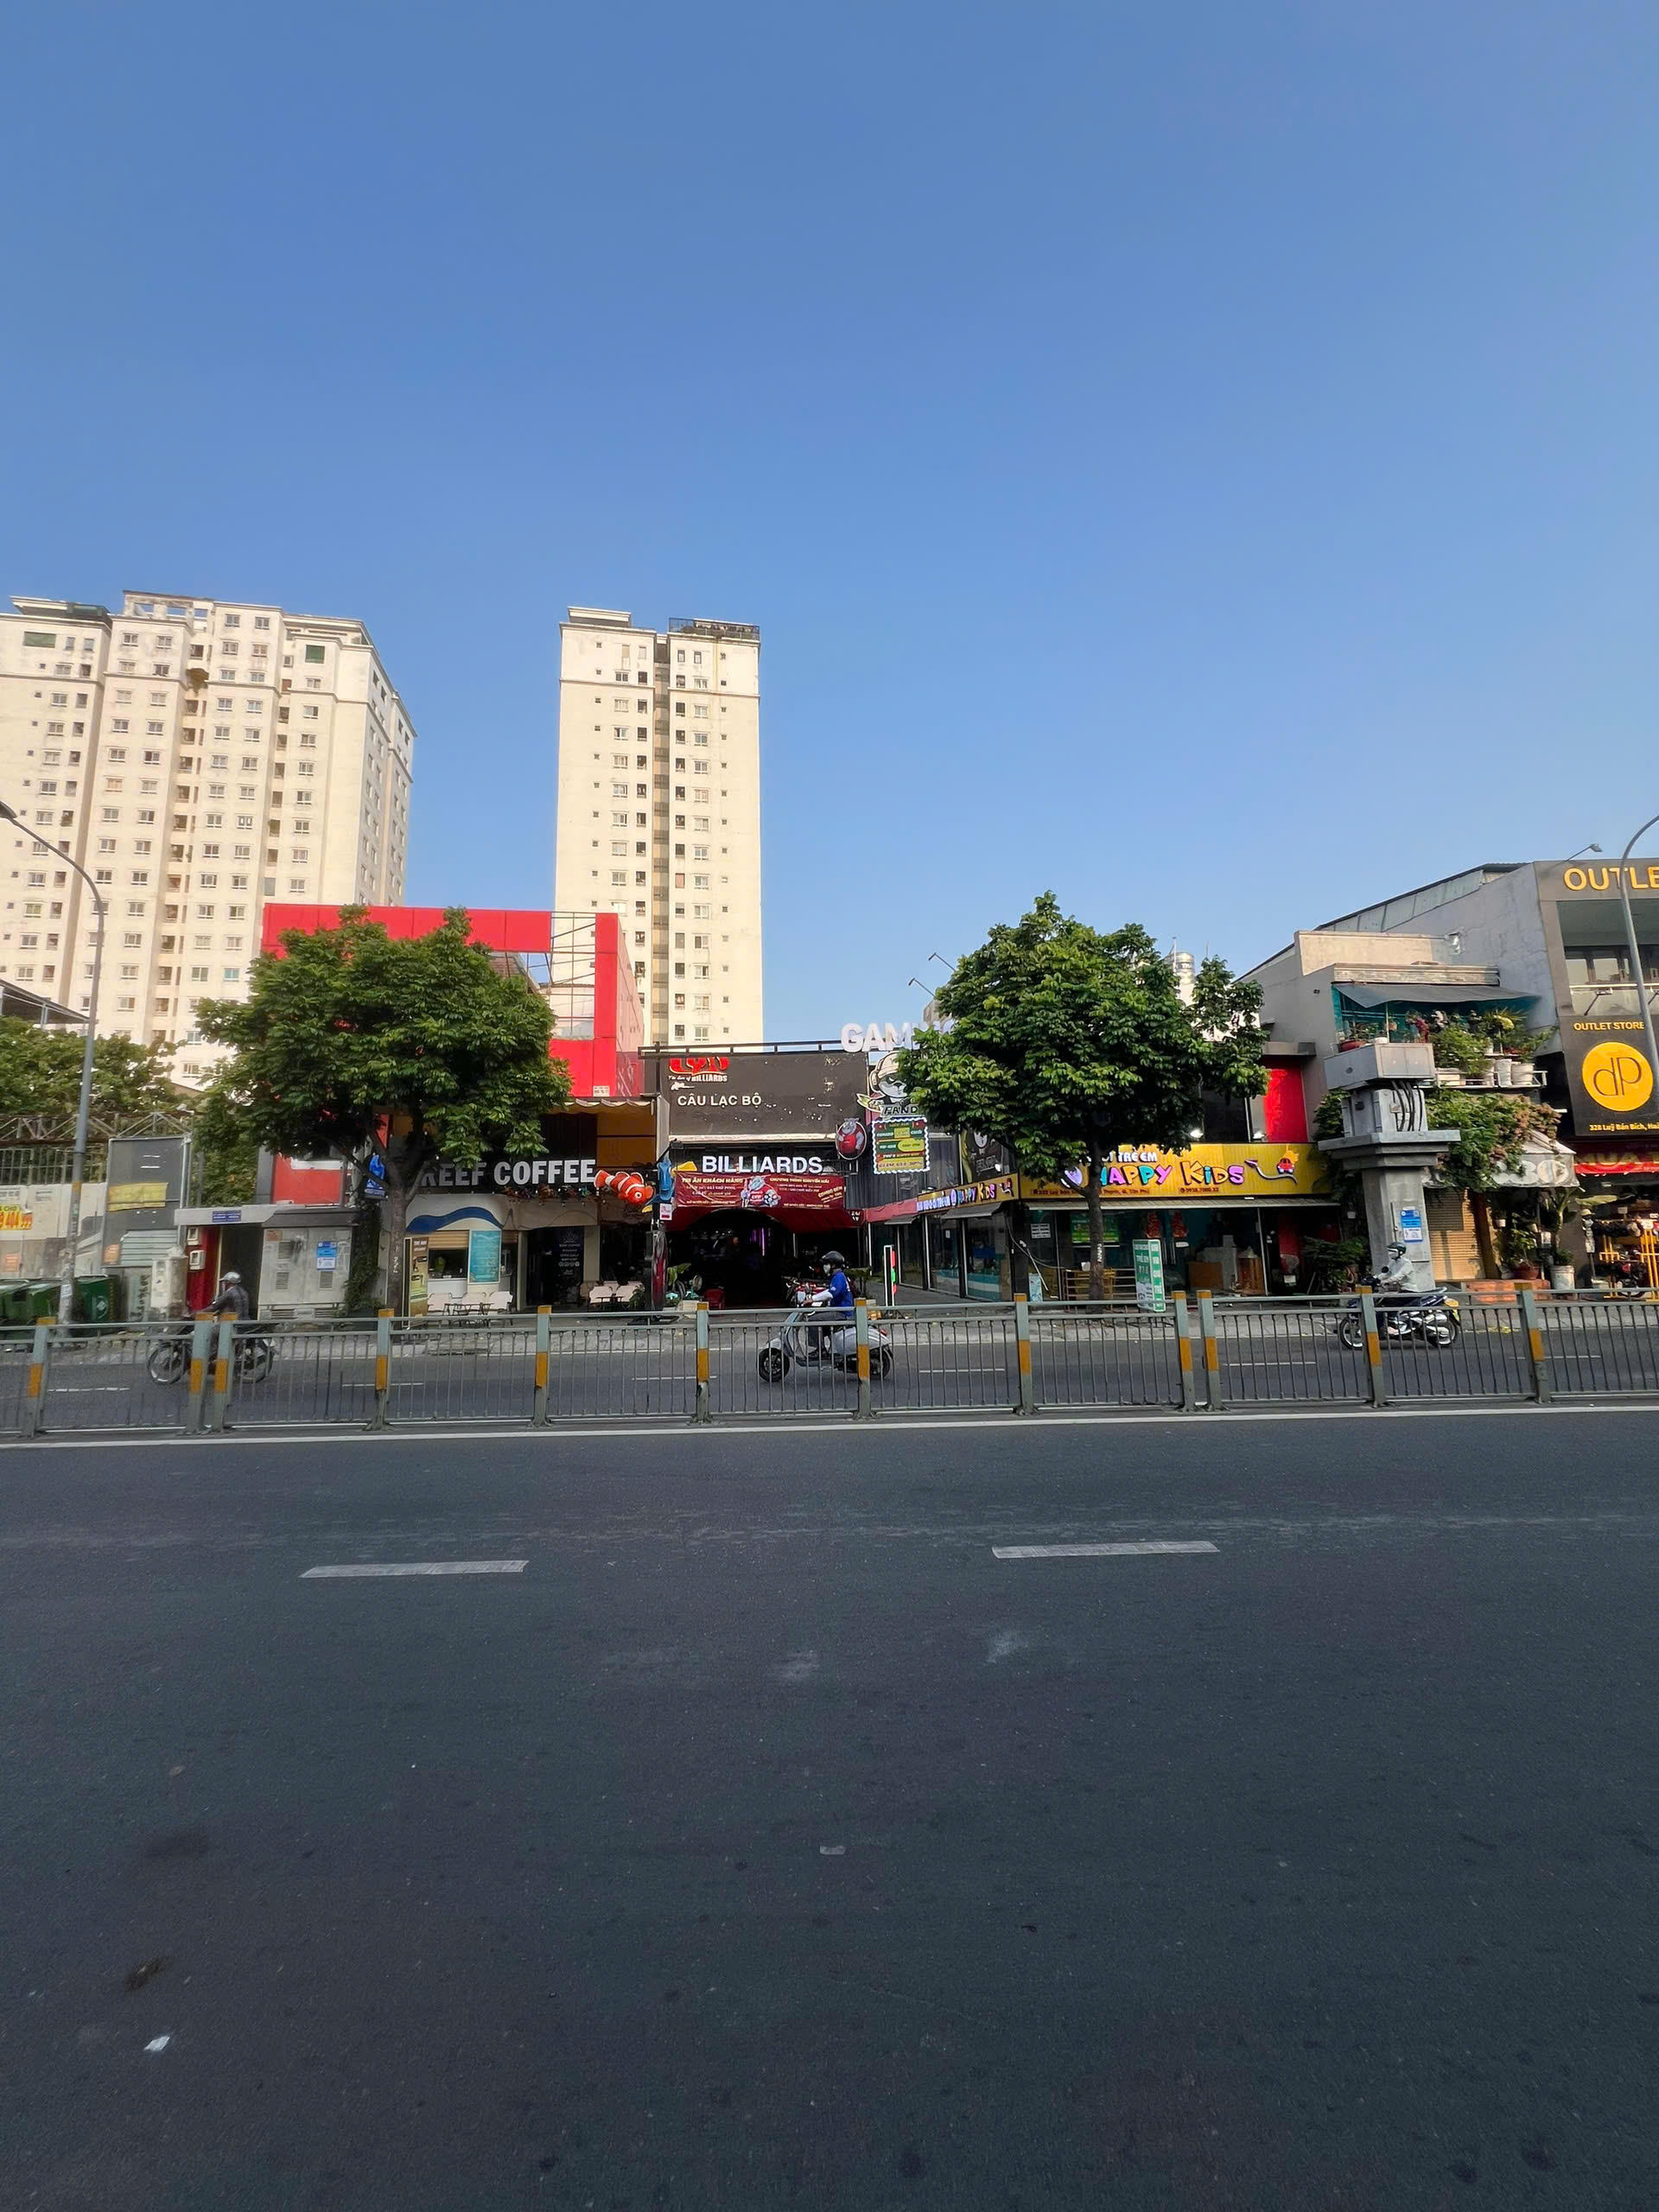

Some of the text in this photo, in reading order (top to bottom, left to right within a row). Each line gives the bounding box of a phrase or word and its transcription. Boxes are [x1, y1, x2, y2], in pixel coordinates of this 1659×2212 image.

[1573, 1021, 1644, 1031] OUTLET STORE
[677, 1092, 762, 1108] CÂU LẠC BỘ
[702, 1155, 823, 1173] BILLIARDS
[1140, 1152, 1158, 1162] EM
[493, 1159, 597, 1185] COFFEE
